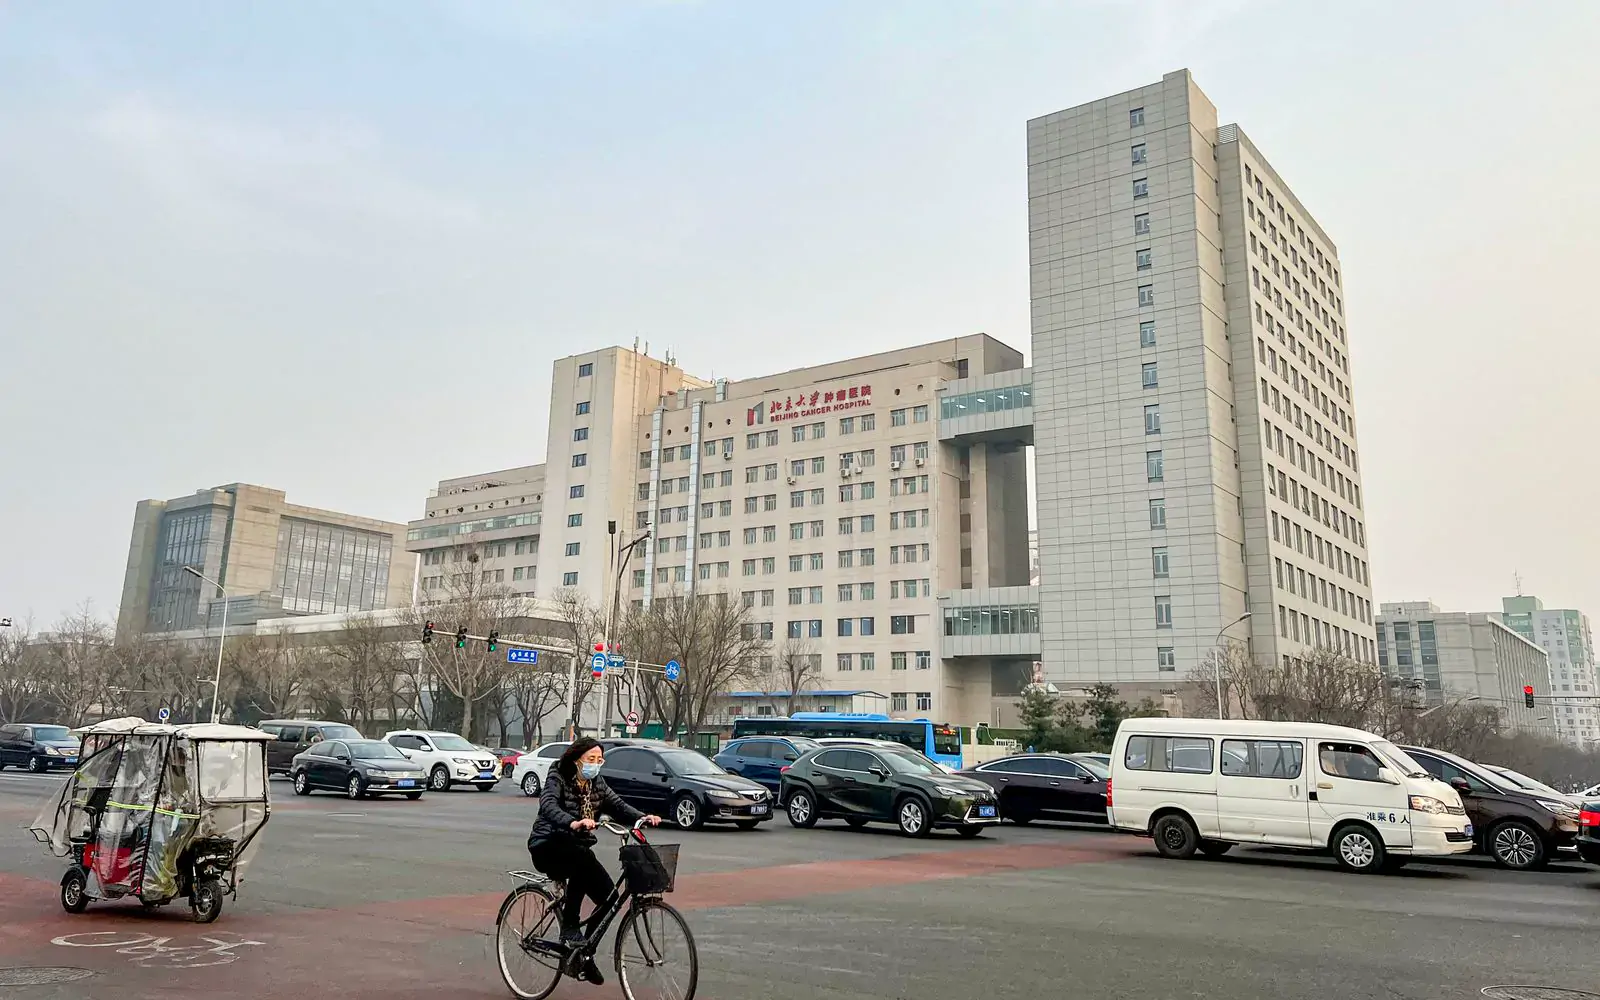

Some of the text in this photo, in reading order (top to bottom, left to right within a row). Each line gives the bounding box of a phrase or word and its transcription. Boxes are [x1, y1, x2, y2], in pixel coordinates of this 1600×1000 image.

[770, 399, 871, 422] BEIJING CANCER HOSPITAL
